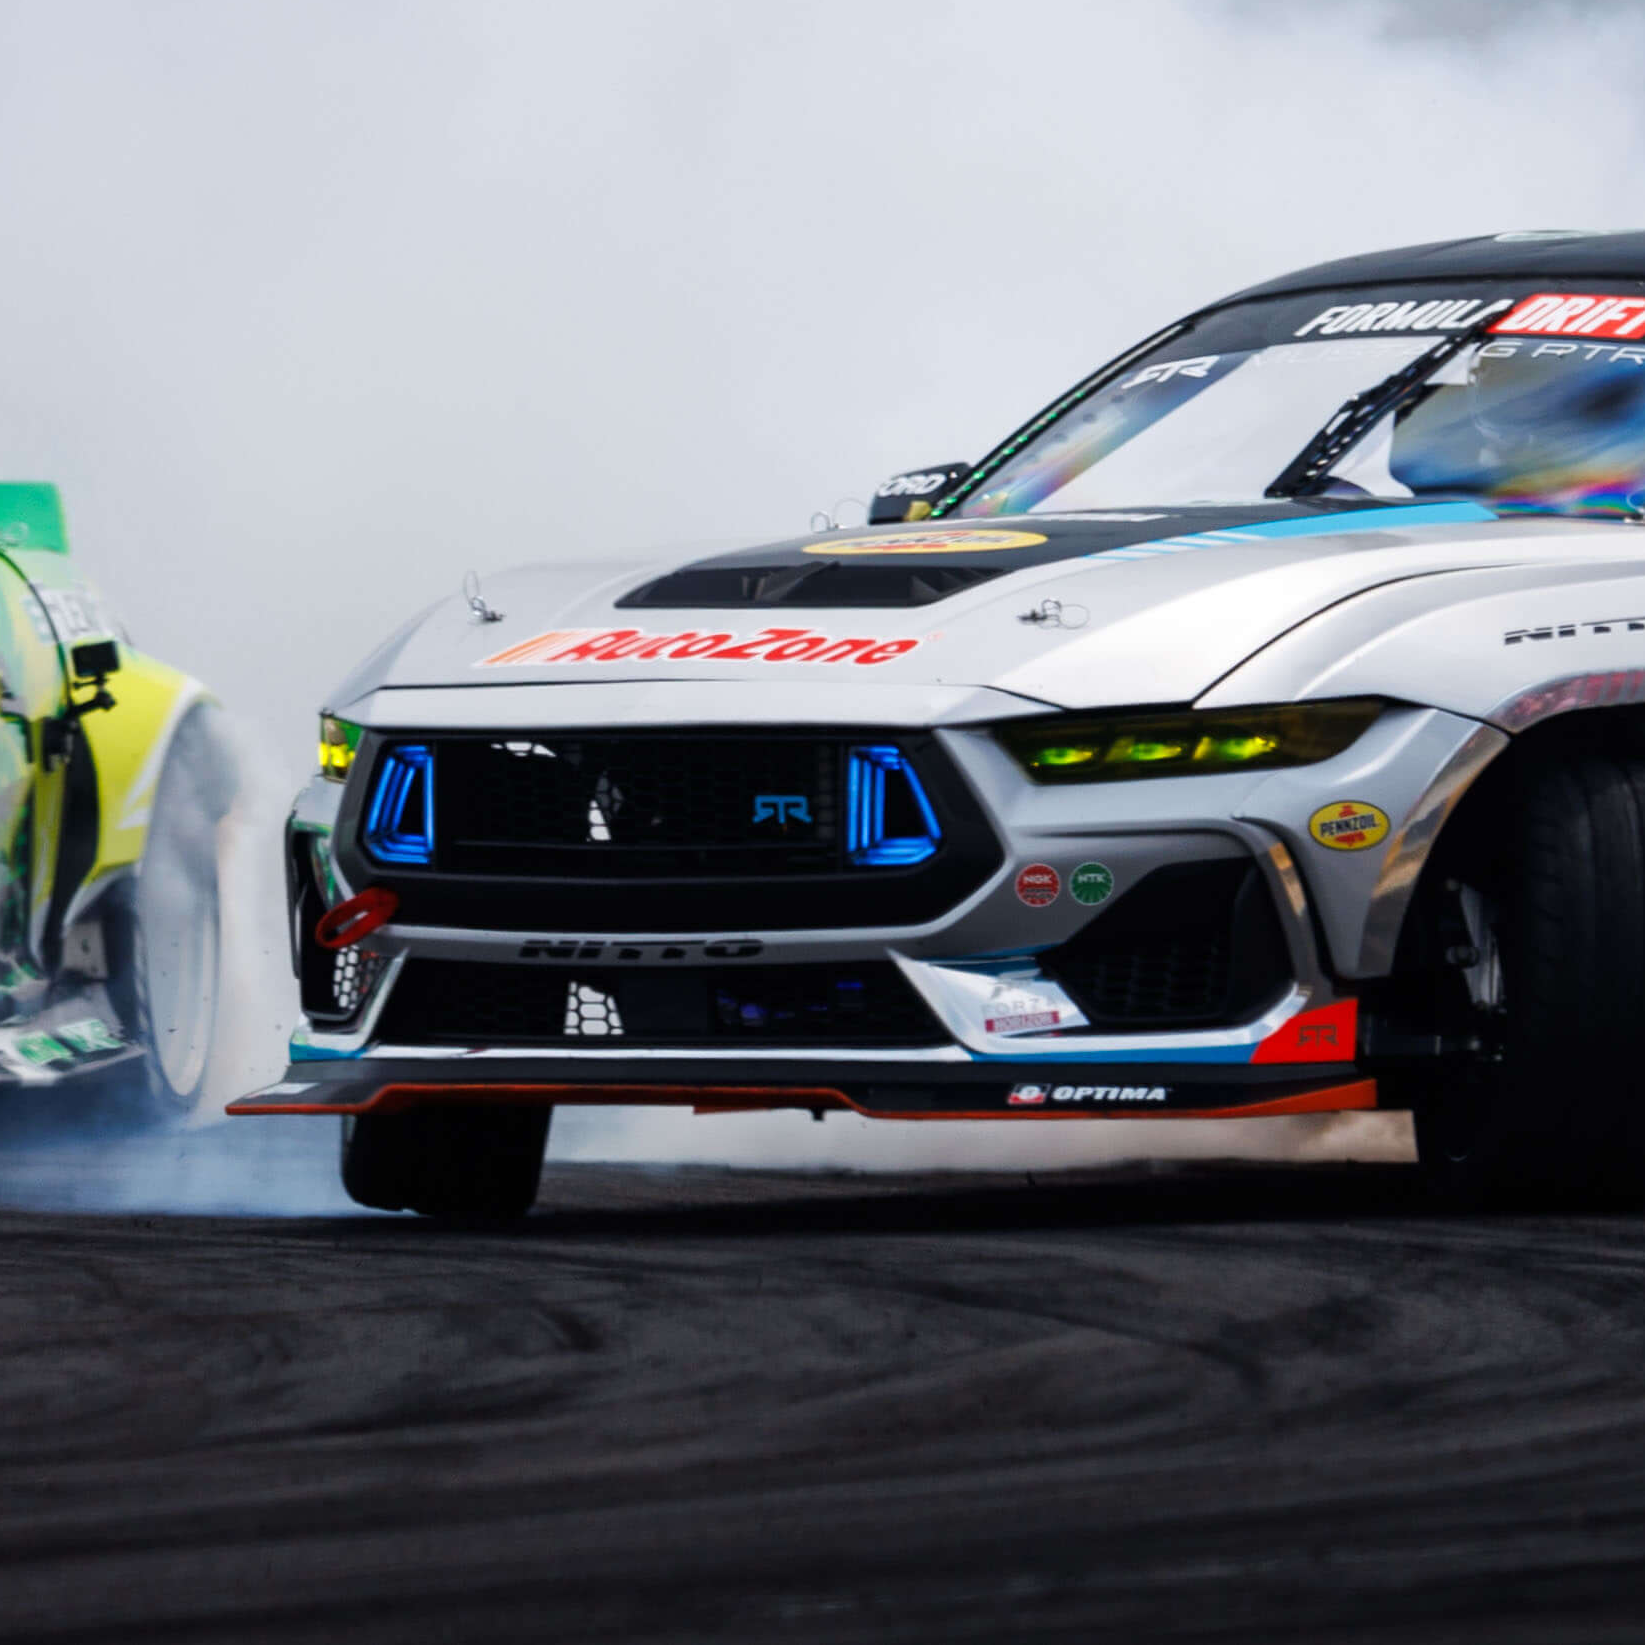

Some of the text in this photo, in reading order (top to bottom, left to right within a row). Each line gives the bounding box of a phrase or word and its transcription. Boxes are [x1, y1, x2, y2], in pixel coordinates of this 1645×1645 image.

[1293, 298, 1514, 337] FORMULA
[545, 628, 921, 666] AutoZone
[1319, 812, 1379, 839] PENNZOIL
[1023, 874, 1053, 884] NGK
[1078, 872, 1105, 884] NTK
[519, 938, 765, 961] NITTO
[1051, 1085, 1167, 1103] OPTIMA
